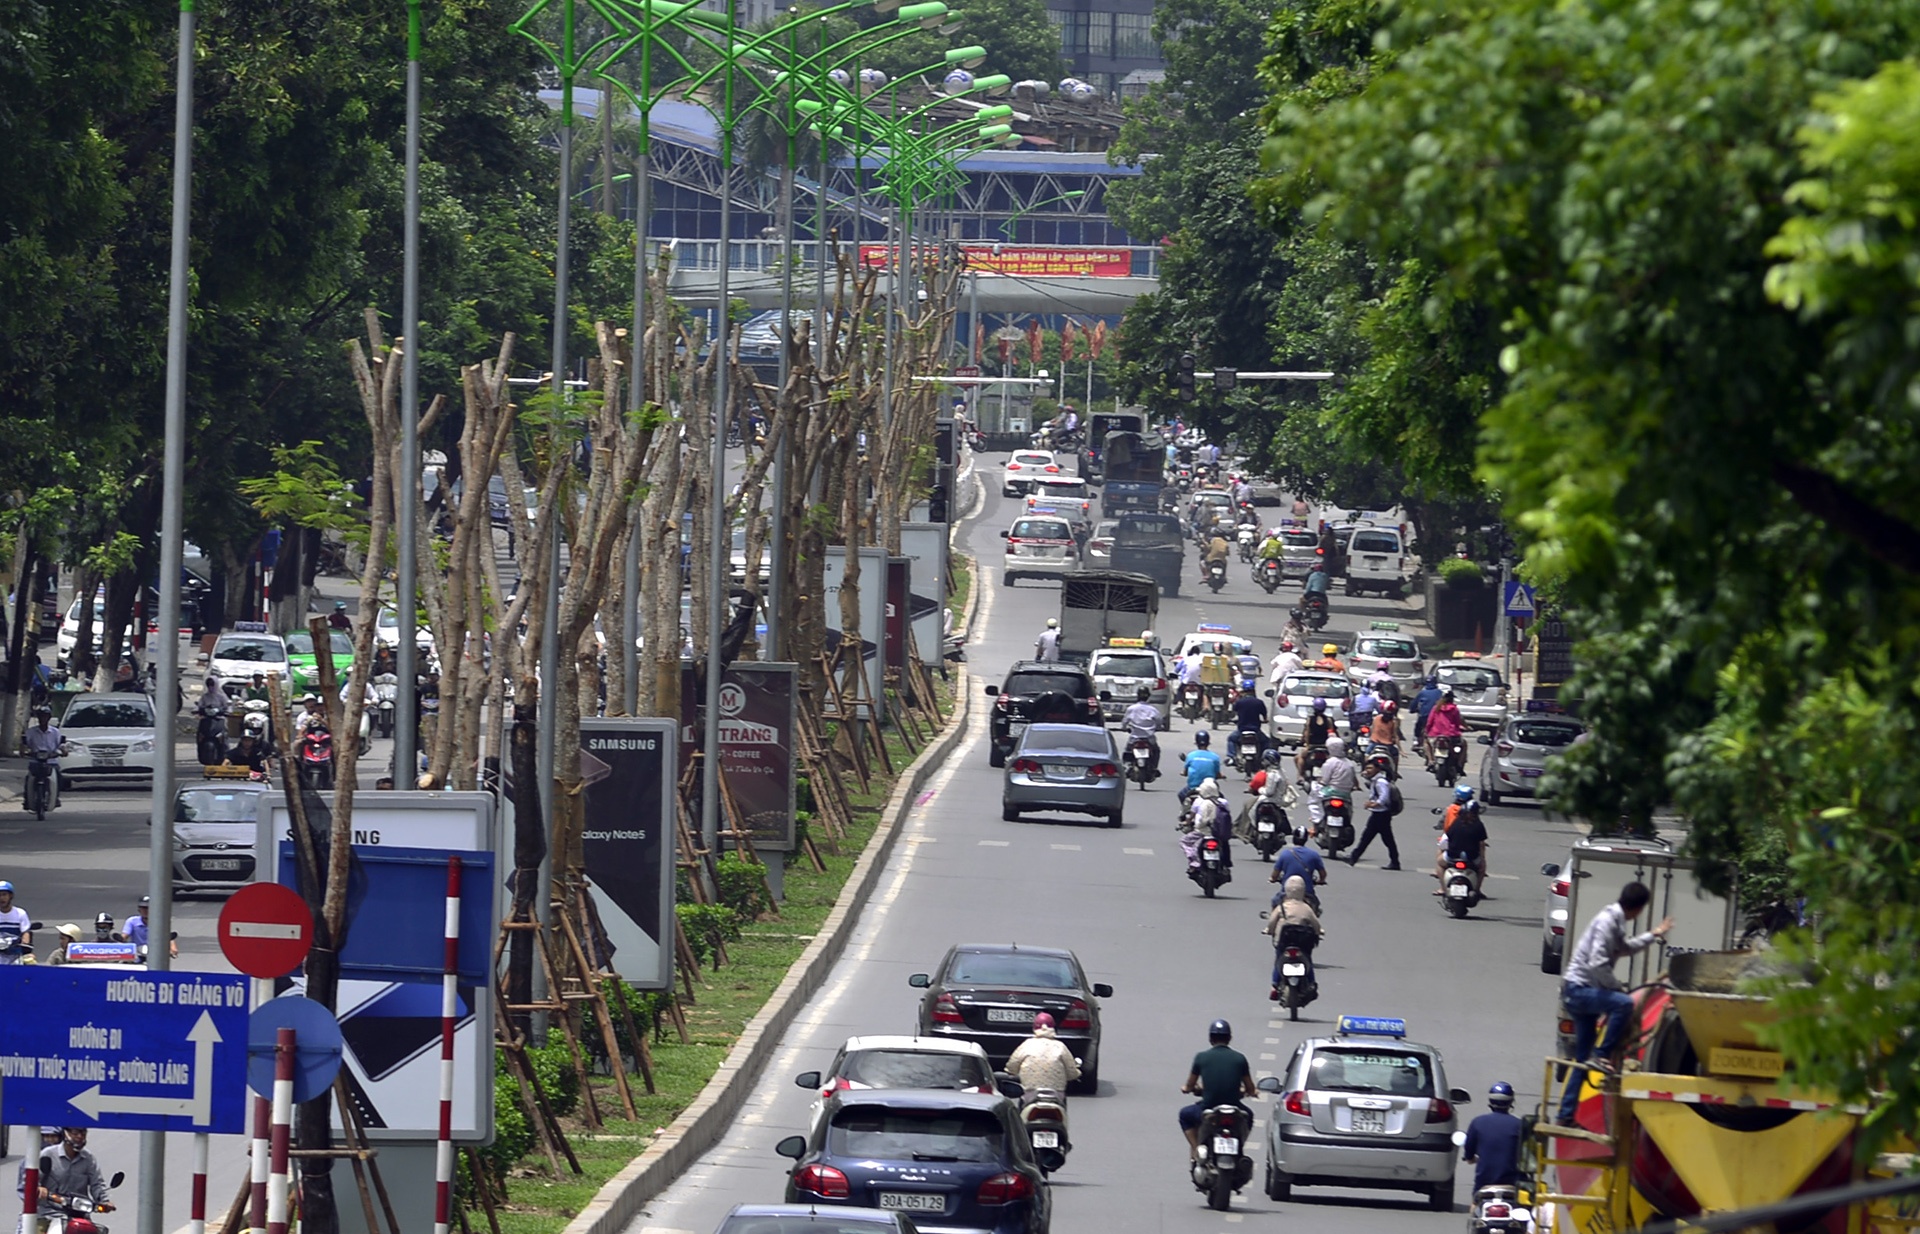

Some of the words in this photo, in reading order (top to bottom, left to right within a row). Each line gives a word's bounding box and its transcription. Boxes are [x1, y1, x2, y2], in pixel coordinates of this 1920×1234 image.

[719, 728, 772, 742] TRANG
[589, 738, 656, 751] SAMSUNG
[732, 750, 761, 759] COFFEE
[581, 829, 612, 842] alaxy
[613, 830, 646, 839] Note5
[106, 976, 156, 1003] HƯỚNG
[178, 977, 222, 1006] GIẢNG
[226, 981, 245, 1007] VÕ
[69, 1021, 107, 1049] HƯỚNG
[109, 1028, 122, 1050] ĐI
[0, 1052, 36, 1078] HUỲNH
[37, 1054, 67, 1079] THÚC
[67, 1055, 106, 1081] KHÁNG
[118, 1056, 157, 1083] ĐƯỜNG
[159, 1058, 189, 1085] LÁNG
